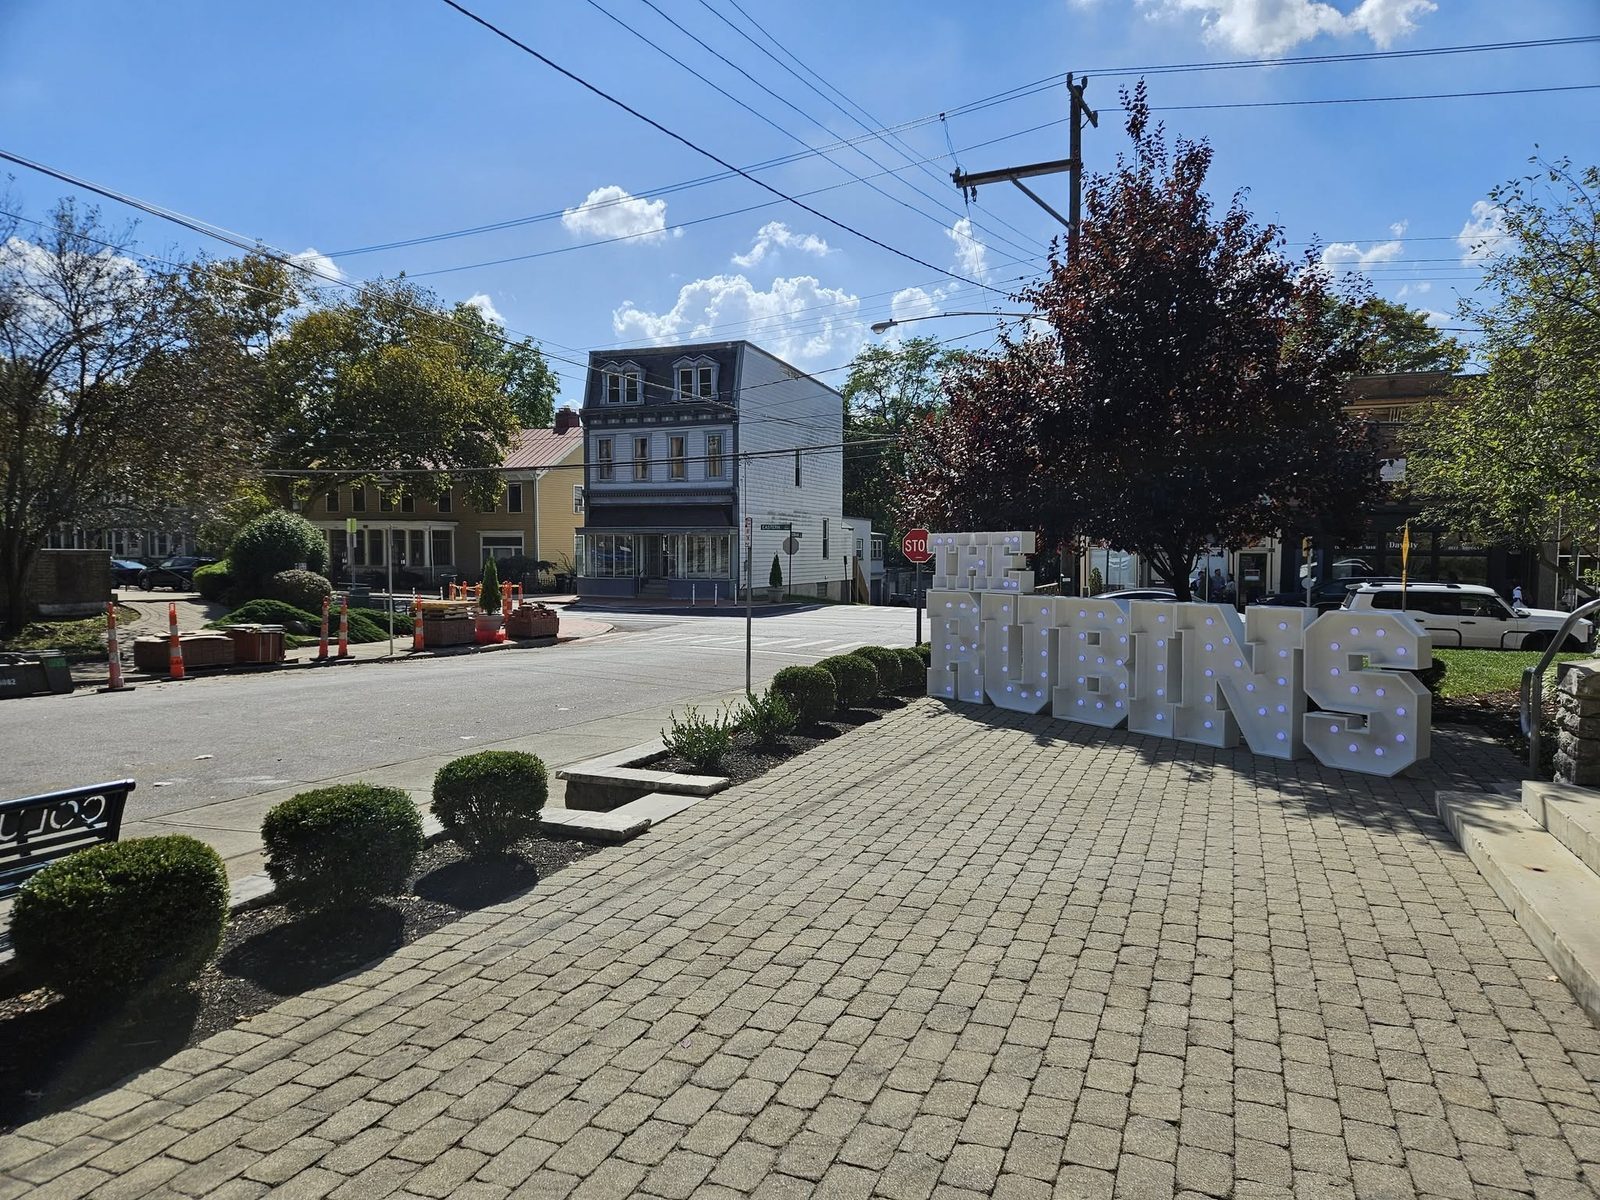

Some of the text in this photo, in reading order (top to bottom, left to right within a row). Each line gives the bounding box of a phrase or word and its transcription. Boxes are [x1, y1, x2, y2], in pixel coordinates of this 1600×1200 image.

[905, 539, 925, 552] STO
[927, 531, 1035, 593] THE
[927, 589, 1432, 777] RUBINS
